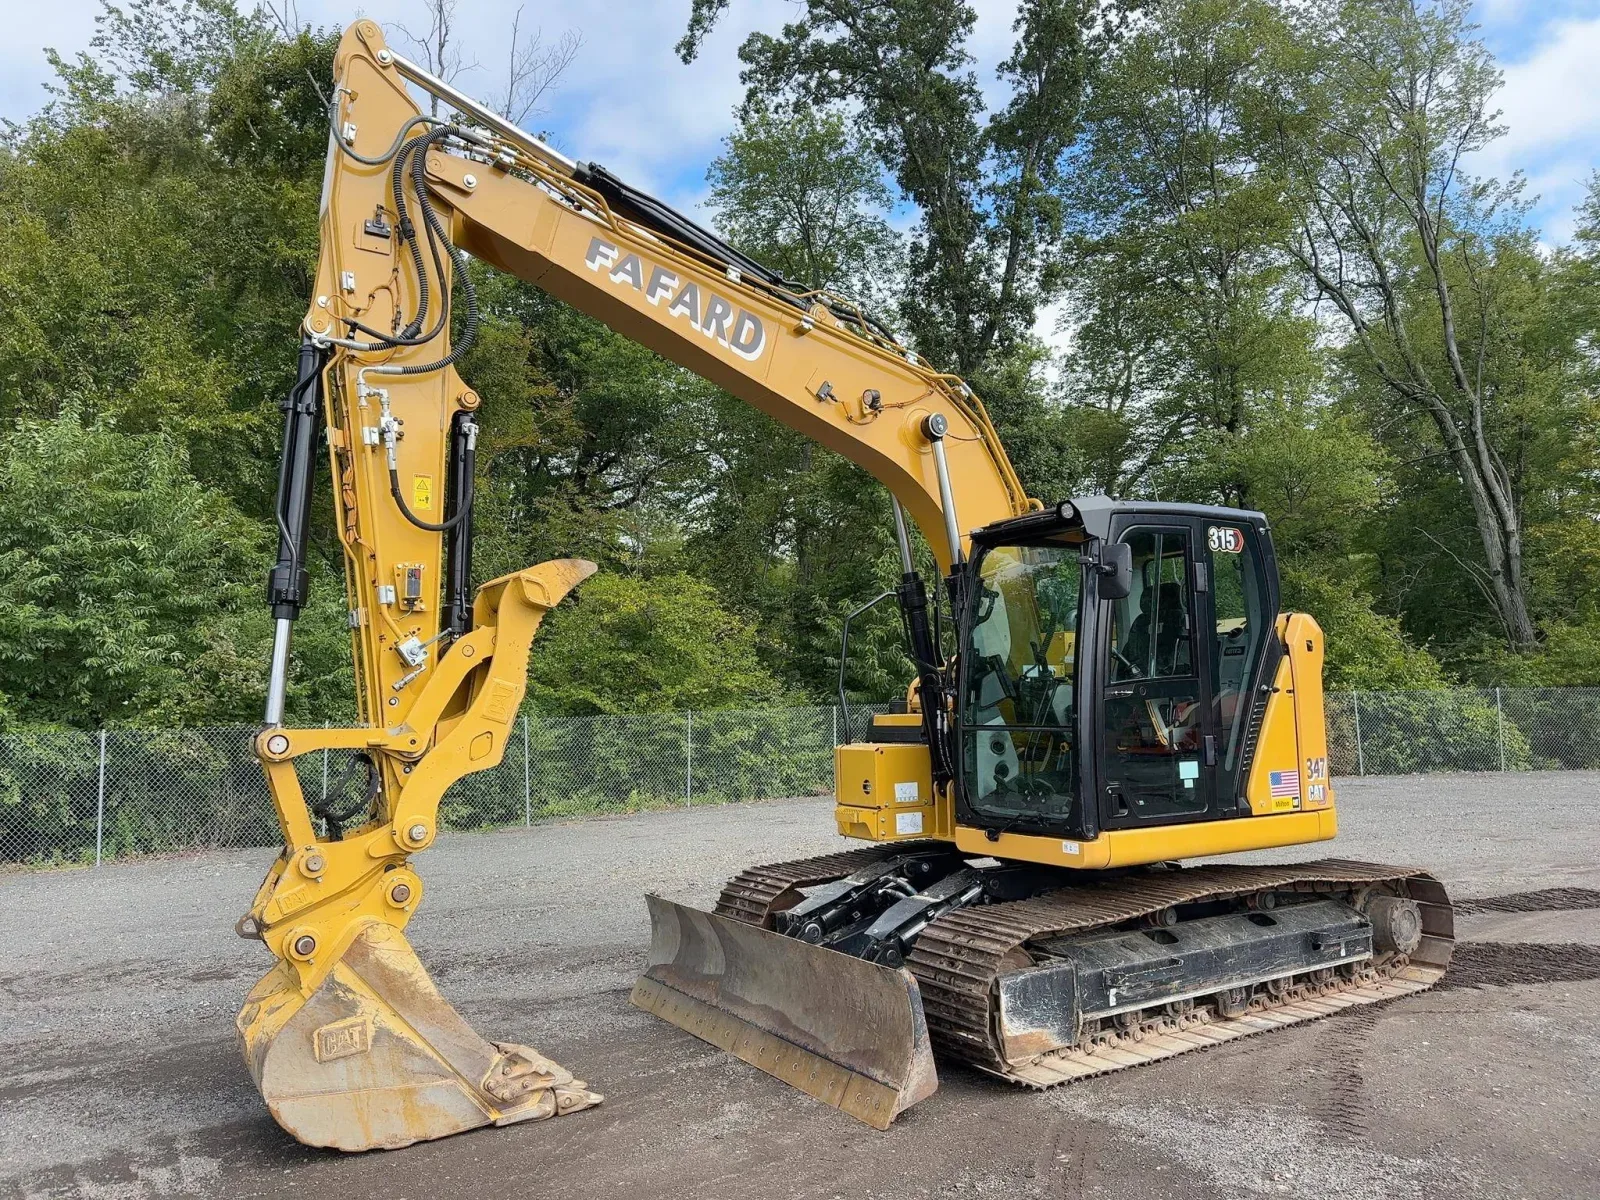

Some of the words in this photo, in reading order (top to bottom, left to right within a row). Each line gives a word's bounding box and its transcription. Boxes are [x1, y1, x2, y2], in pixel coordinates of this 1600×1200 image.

[585, 236, 766, 362] FAFARD
[1209, 527, 1236, 550] 315
[1306, 757, 1327, 780] 347
[1308, 784, 1325, 802] CAT
[323, 1025, 363, 1056] CAT
